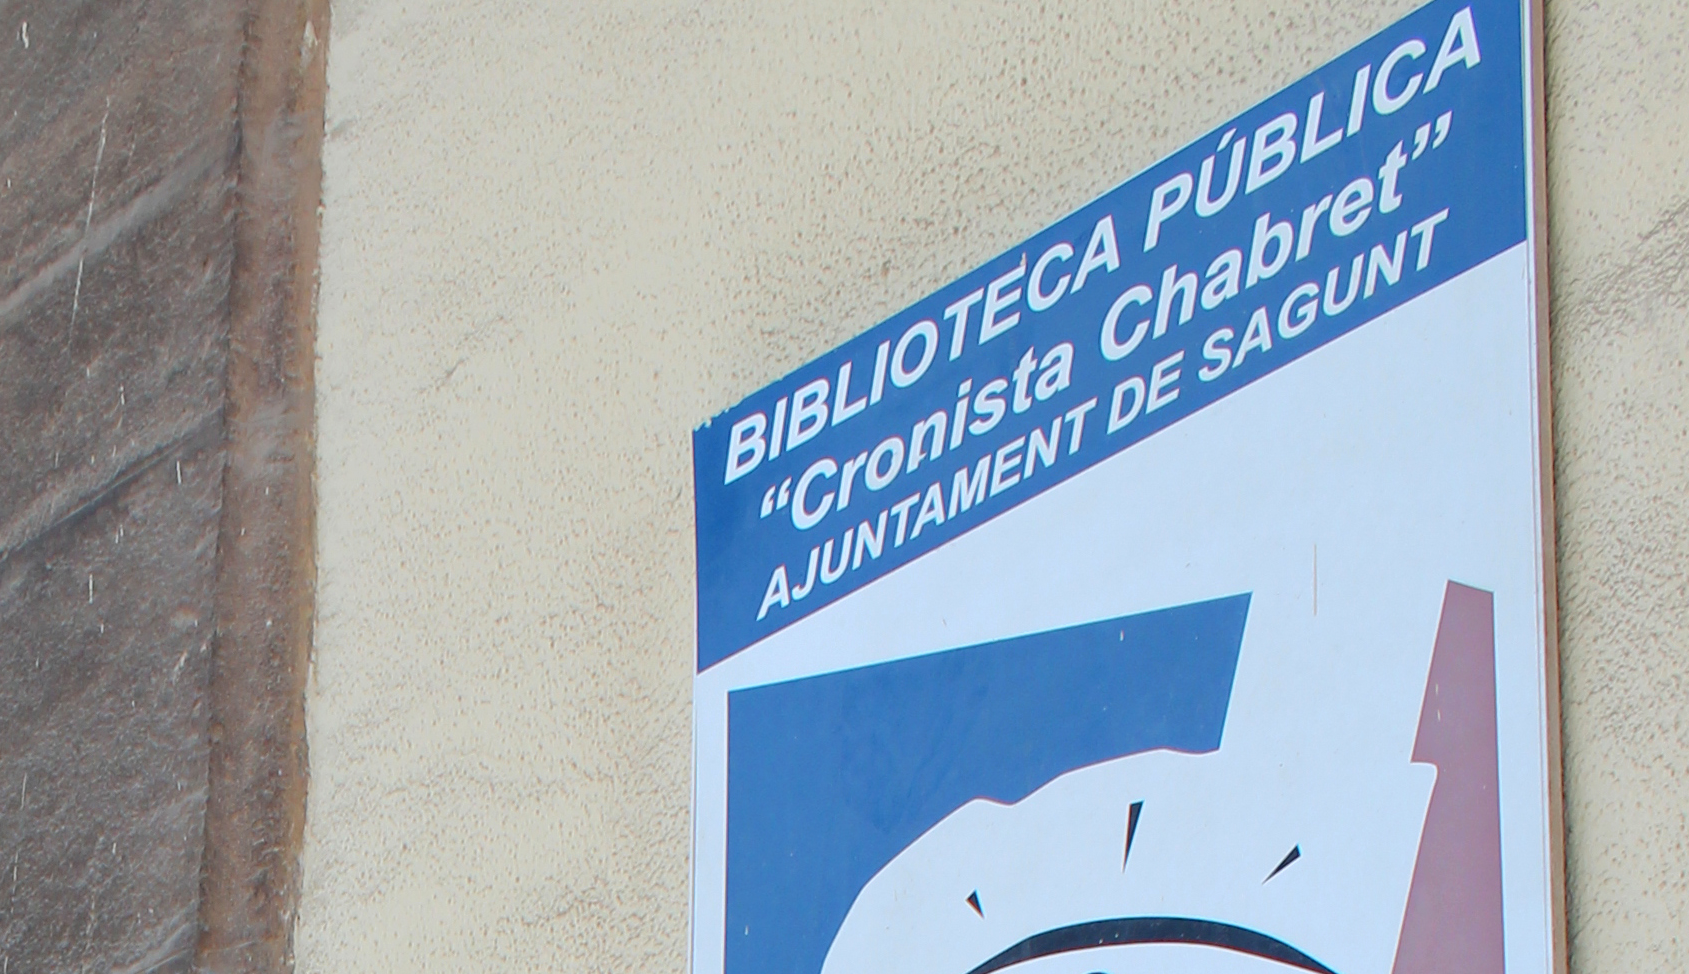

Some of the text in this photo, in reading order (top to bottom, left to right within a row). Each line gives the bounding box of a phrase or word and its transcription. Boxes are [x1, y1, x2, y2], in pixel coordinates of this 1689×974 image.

[723, 6, 1482, 485] BIBLIOTECA PÚBLICA
[755, 207, 1451, 621] AJUNTAMENT DE SAGUNT
[759, 110, 1454, 532] “Cronista Chabret”
